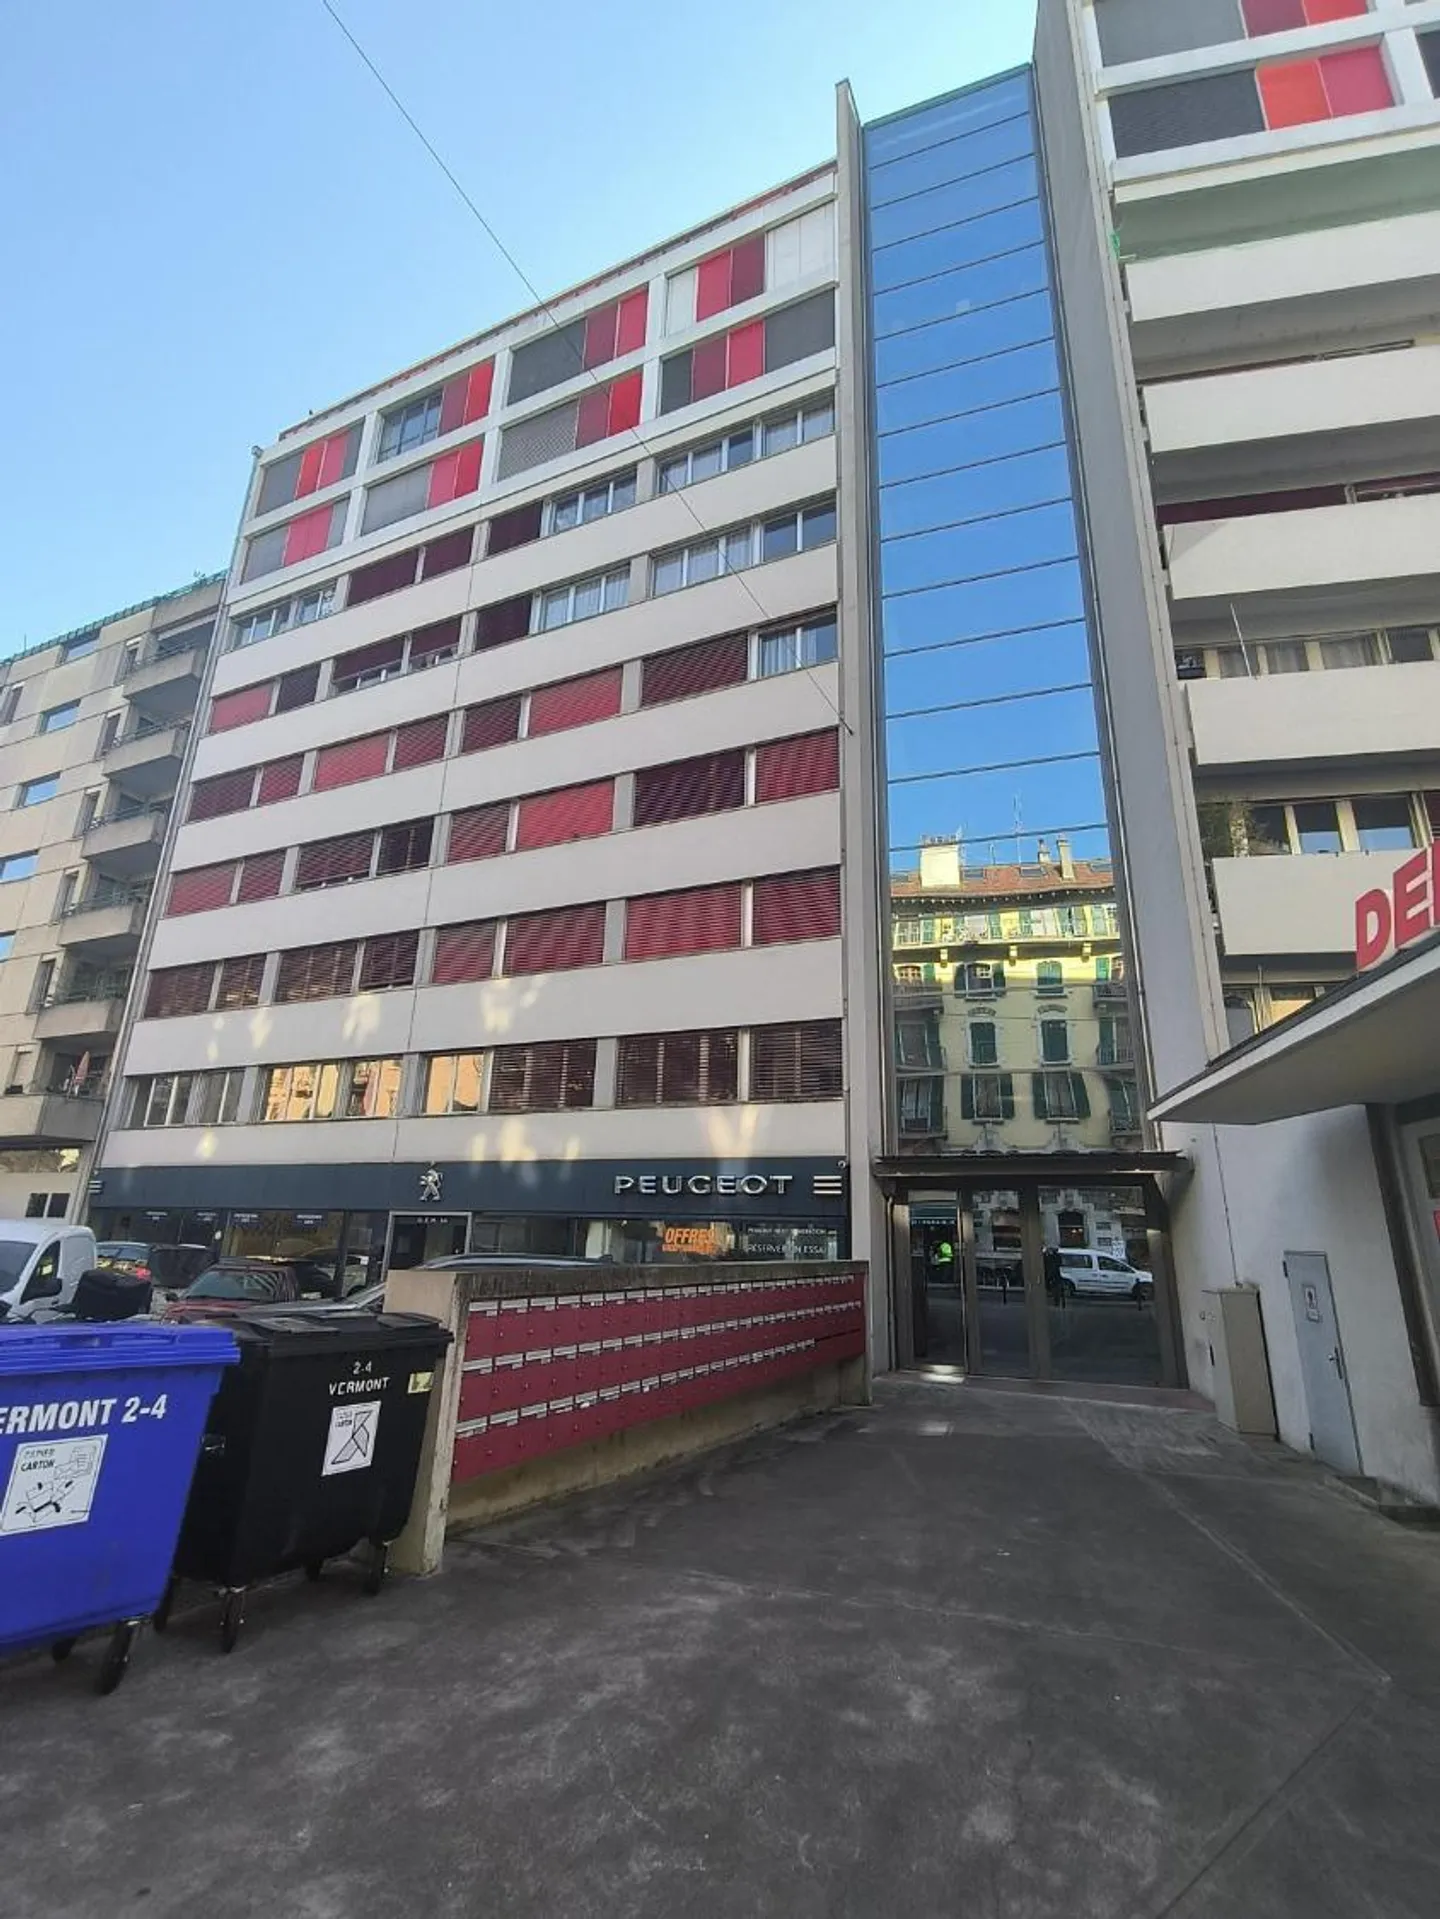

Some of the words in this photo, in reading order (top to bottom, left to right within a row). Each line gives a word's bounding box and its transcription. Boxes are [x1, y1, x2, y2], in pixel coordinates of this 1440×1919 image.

[1355, 837, 1440, 973] DE
[614, 1175, 793, 1194] PEUGEOT
[329, 1376, 391, 1395] VERMONT
[121, 1394, 168, 1423] 2-4
